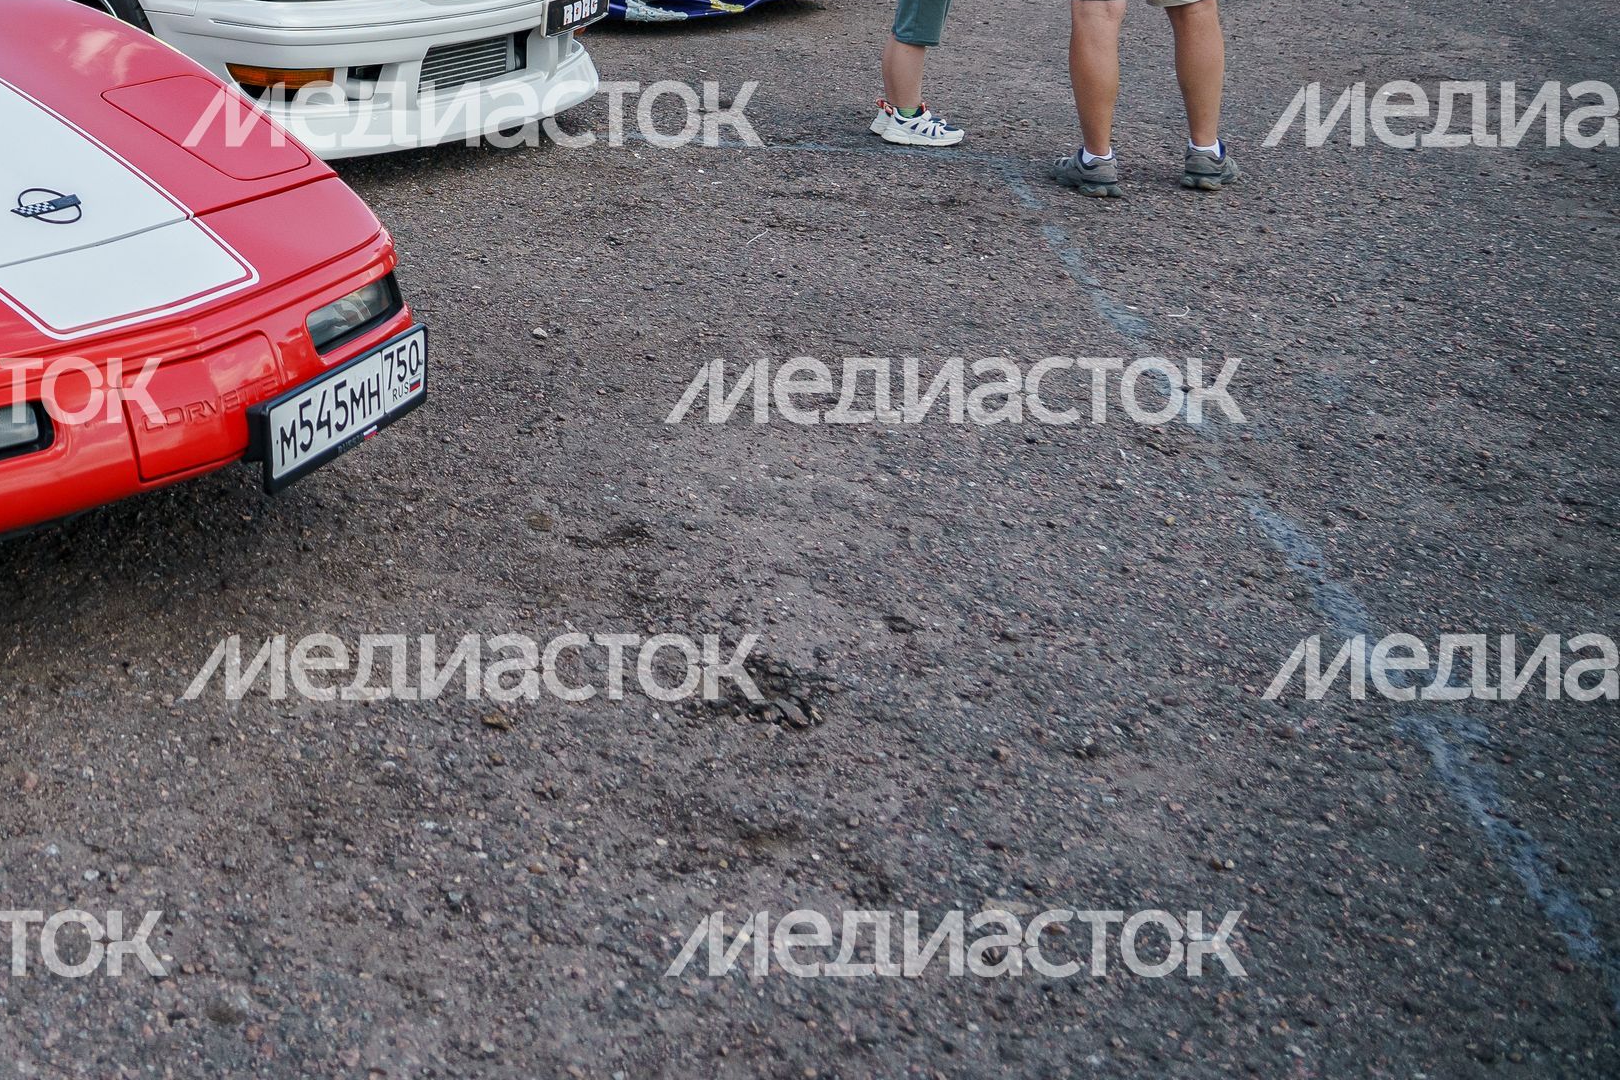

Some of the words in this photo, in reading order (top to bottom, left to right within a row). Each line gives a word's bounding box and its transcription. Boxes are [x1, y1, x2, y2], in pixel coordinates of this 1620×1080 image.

[384, 339, 420, 391] 750
[141, 373, 278, 433] CORVETTE
[392, 381, 410, 402] RUS
